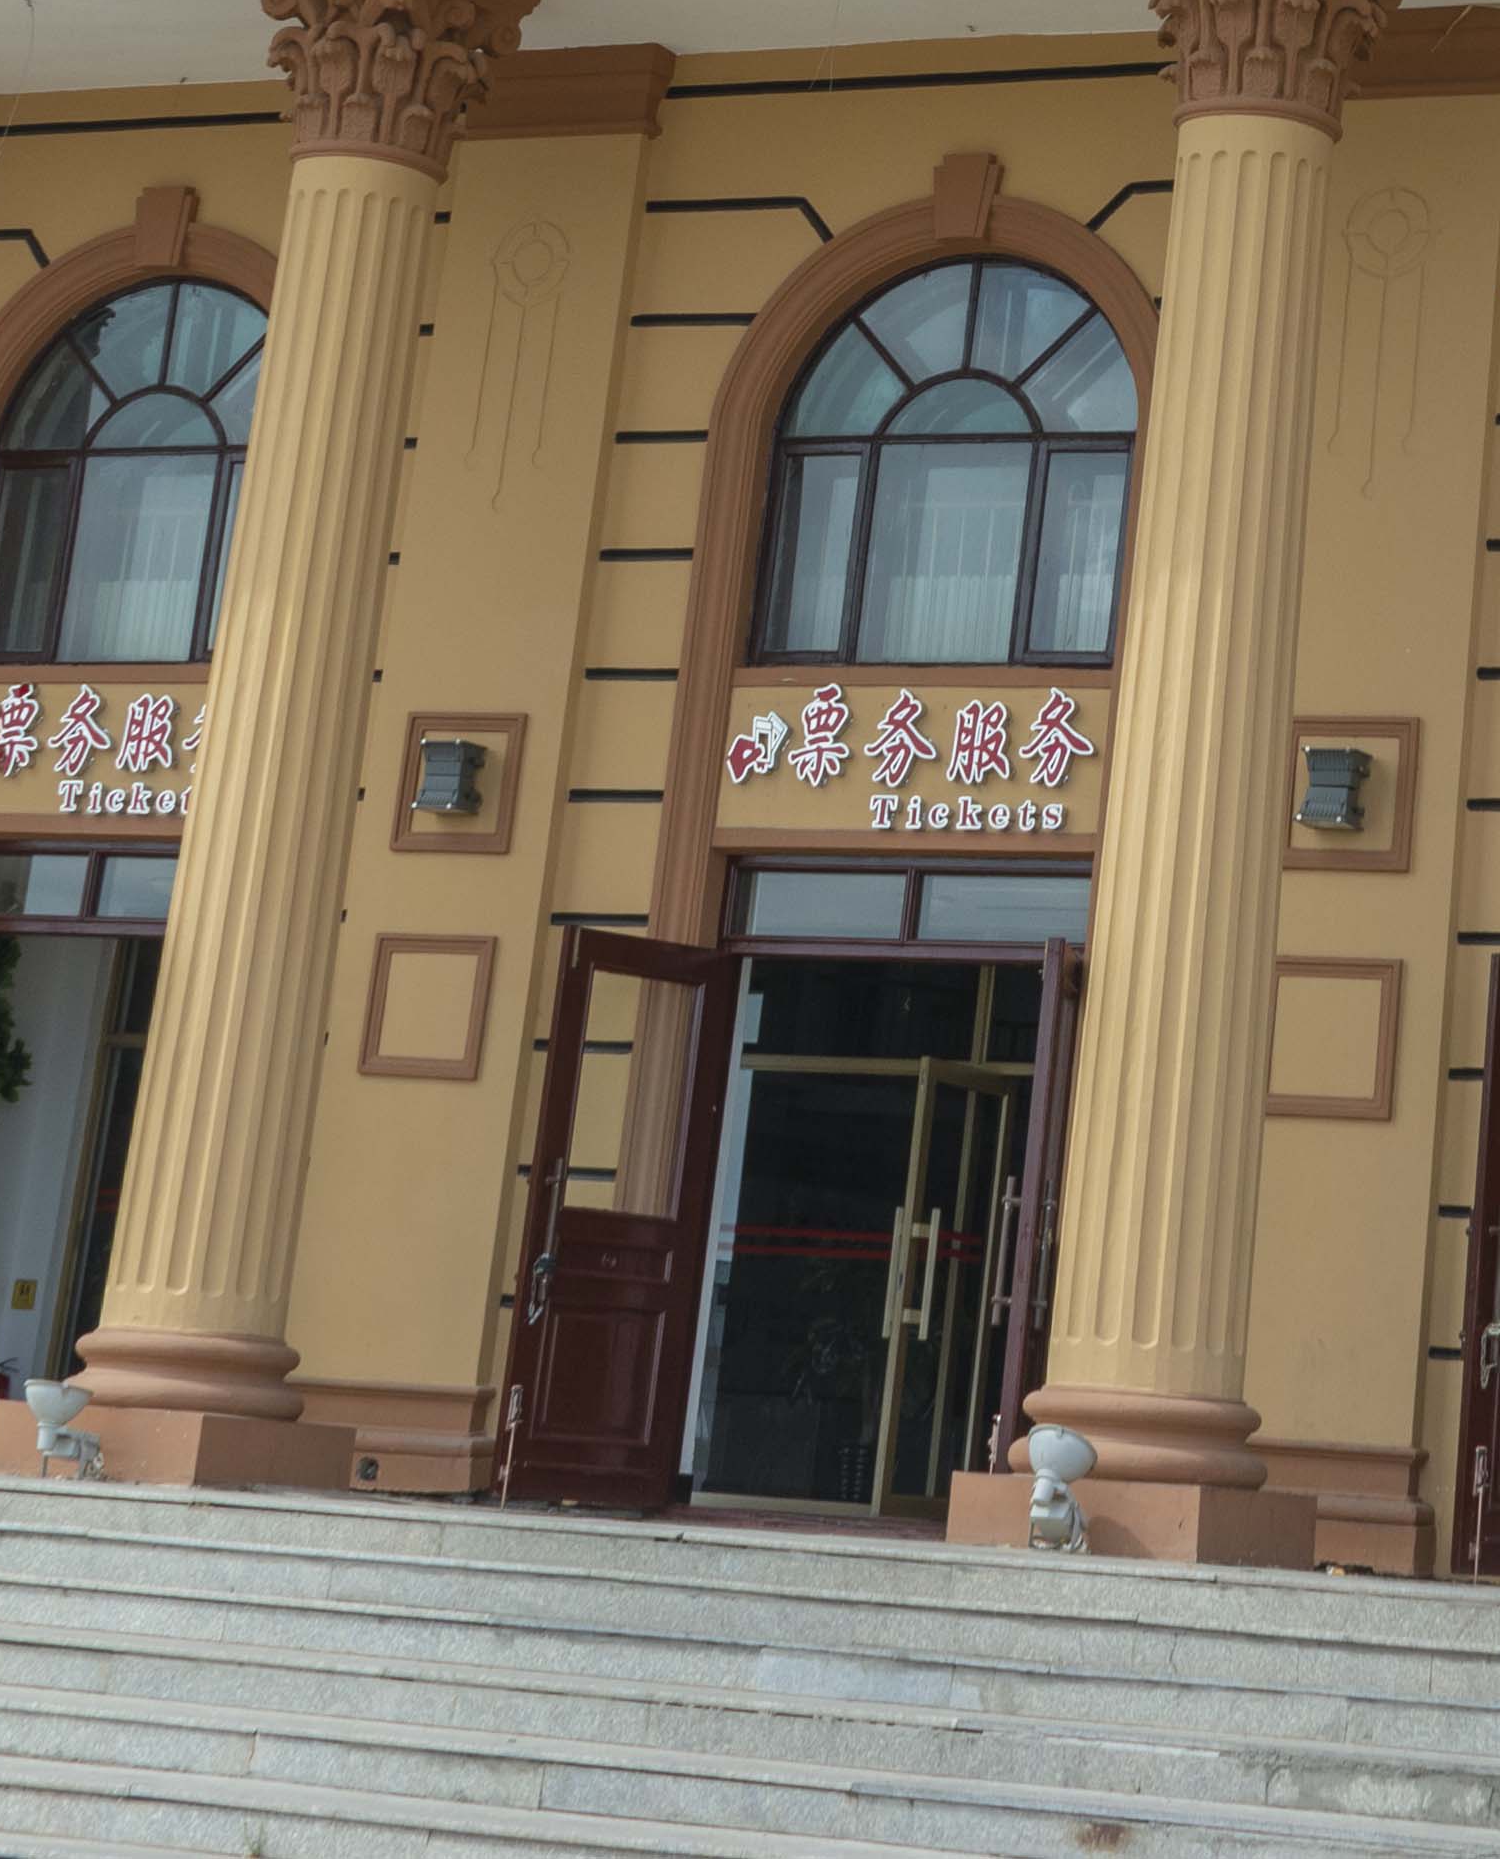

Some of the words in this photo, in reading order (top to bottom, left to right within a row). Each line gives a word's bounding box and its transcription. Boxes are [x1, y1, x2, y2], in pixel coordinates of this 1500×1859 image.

[788, 683, 1095, 788] 票务服务
[870, 794, 1065, 832] Tickets
